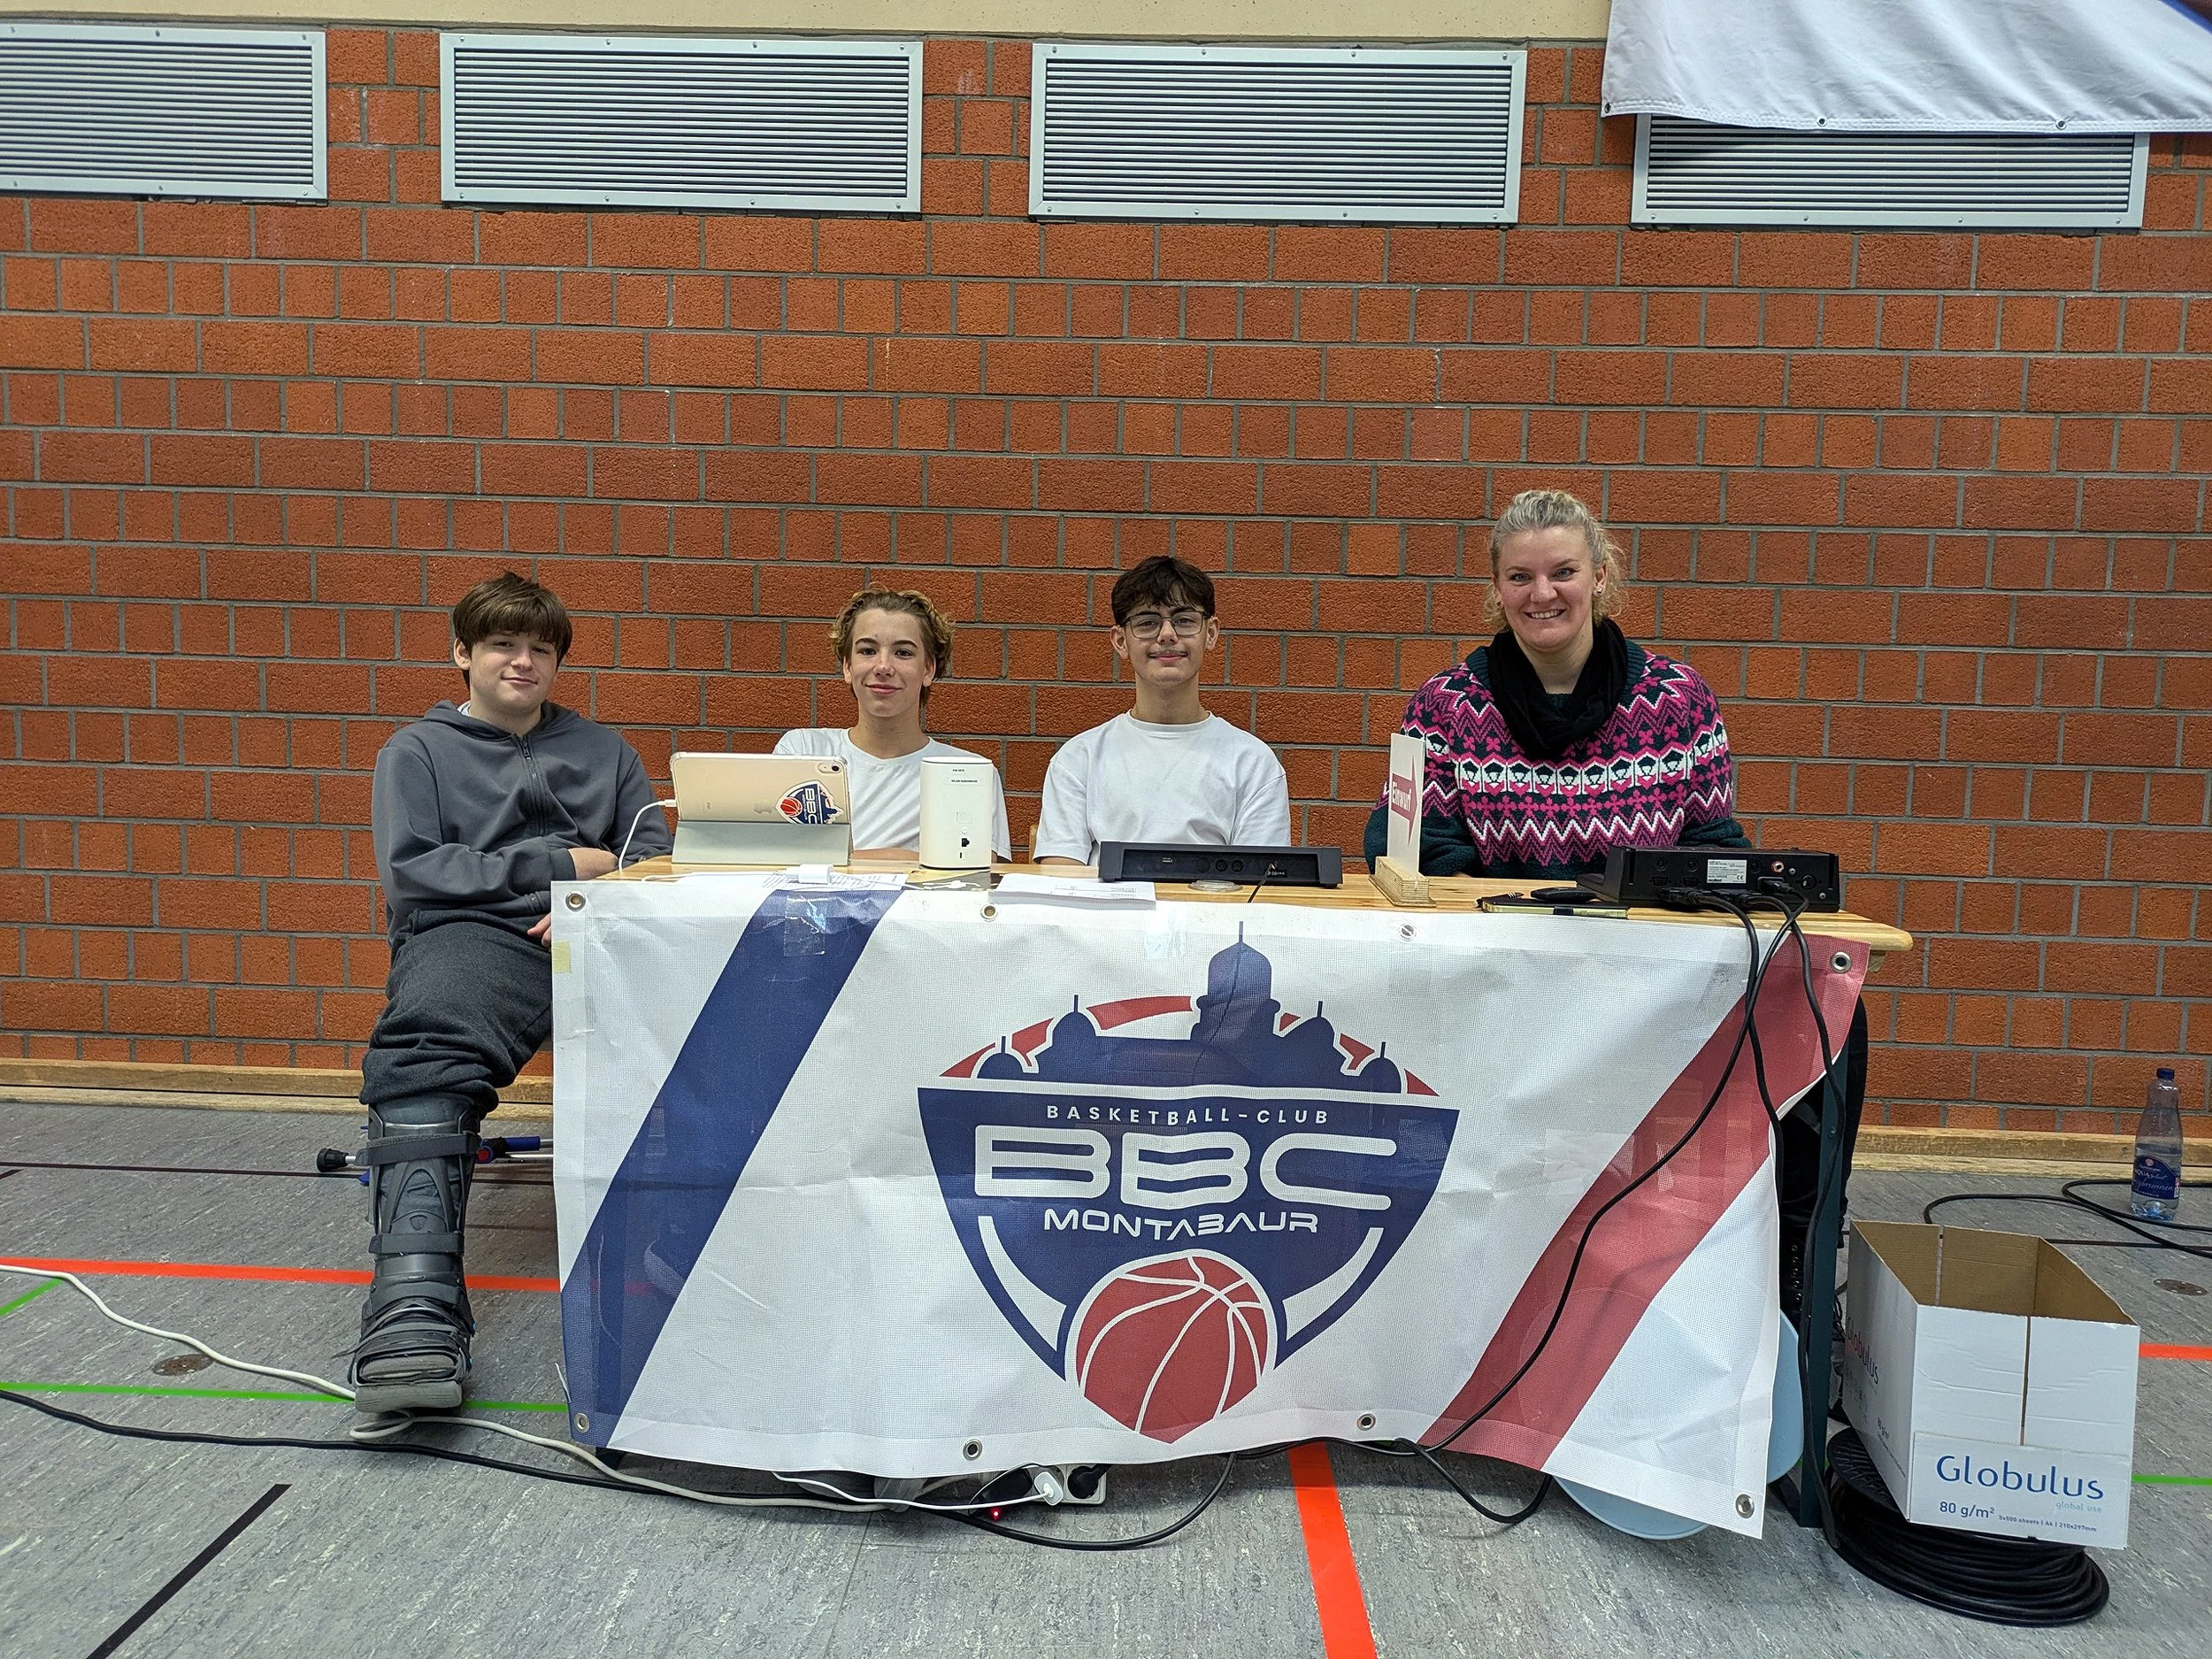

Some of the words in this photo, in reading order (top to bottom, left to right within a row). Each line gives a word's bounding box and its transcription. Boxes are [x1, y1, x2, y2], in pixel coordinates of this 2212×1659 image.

[1047, 1105, 1328, 1125] BASKETBALL-CLUB
[974, 1124, 1397, 1211] BBC
[1043, 1208, 1318, 1241] MONTABAUR
[1936, 1455, 2104, 1500] Globulus
[1939, 1502, 1956, 1514] 80
[2055, 1501, 2084, 1511] global
[2059, 1523, 2097, 1532] 210x297mm
